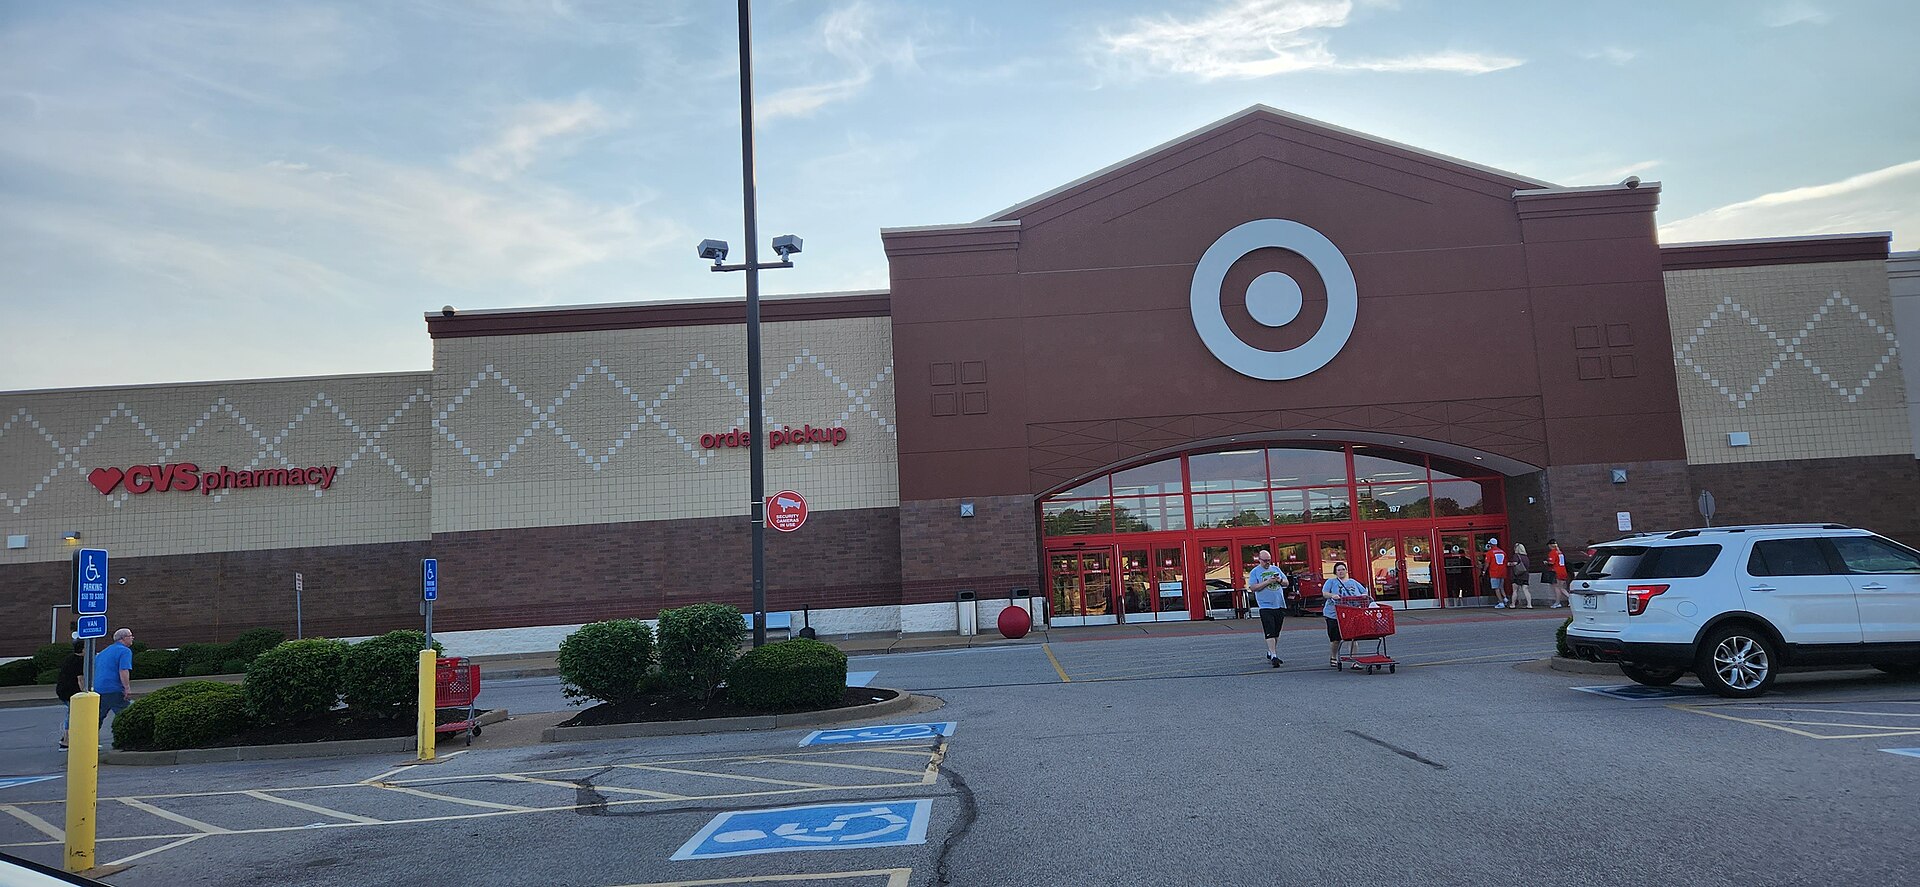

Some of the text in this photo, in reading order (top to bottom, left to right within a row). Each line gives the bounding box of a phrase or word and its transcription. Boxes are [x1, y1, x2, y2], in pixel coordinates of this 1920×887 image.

[700, 424, 847, 450] orde pickup
[123, 463, 338, 496] CVS pharmacy
[83, 582, 103, 592] PARKING
